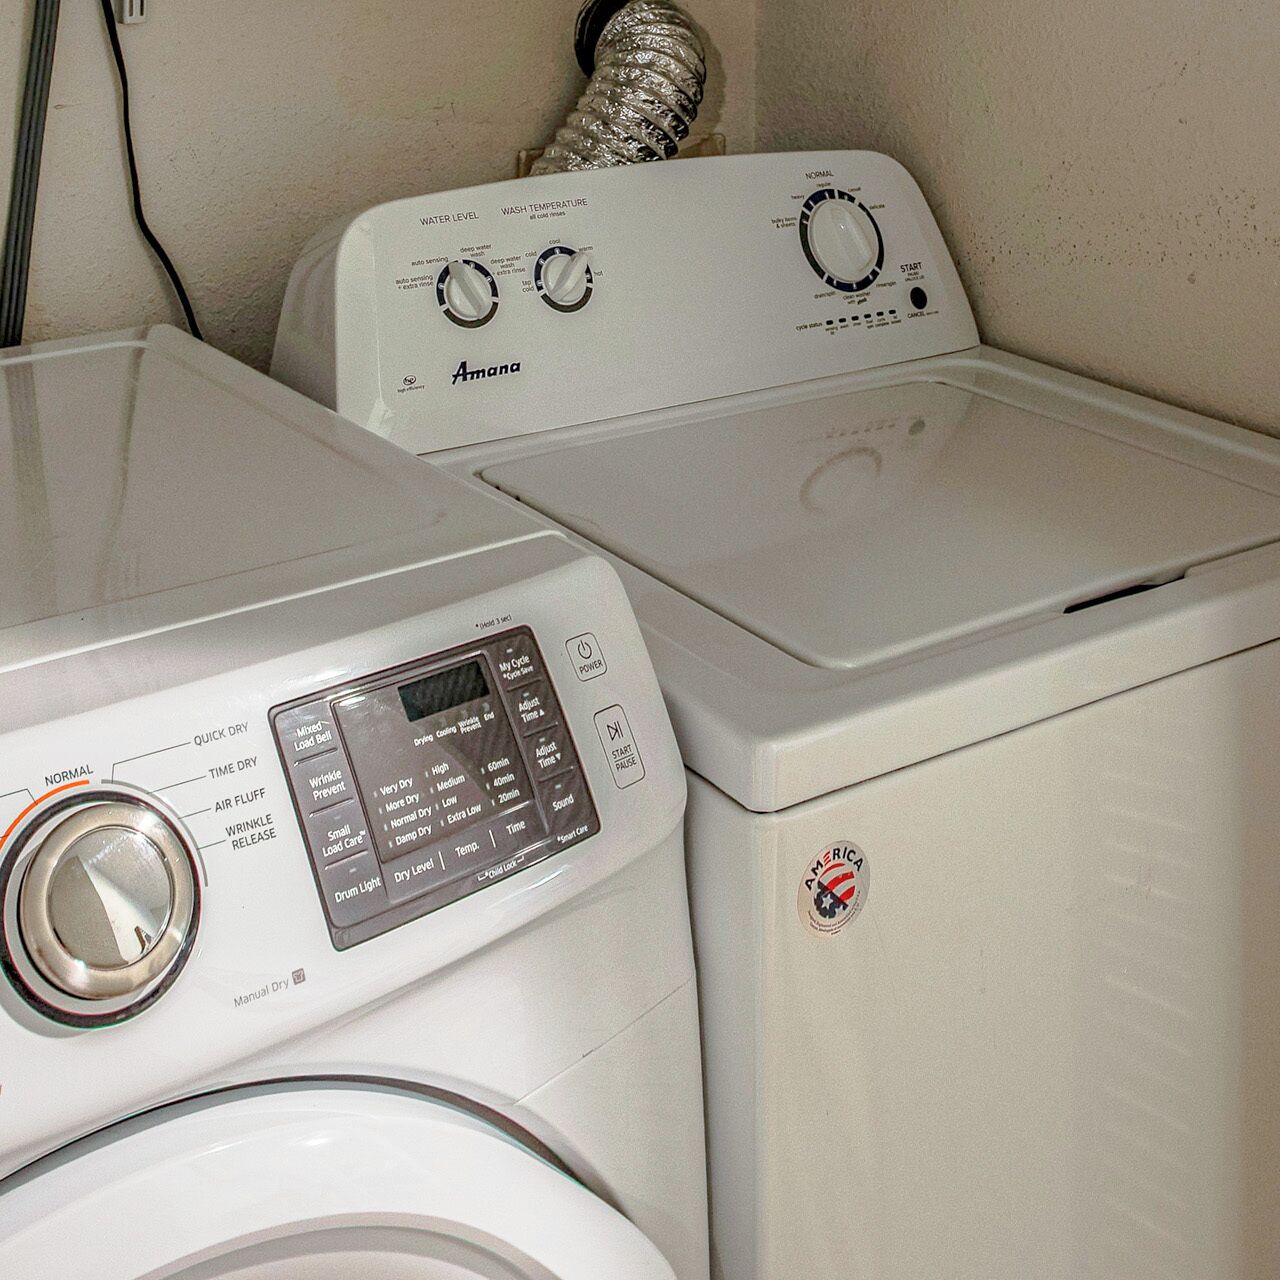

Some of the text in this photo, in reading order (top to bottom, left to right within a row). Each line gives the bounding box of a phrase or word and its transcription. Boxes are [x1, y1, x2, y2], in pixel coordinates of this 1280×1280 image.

[805, 170, 834, 179] NORMAL
[501, 198, 588, 215] WASH TEMPERATURE
[419, 211, 479, 225] WATER LEVEL
[425, 256, 449, 265] sensing
[900, 262, 923, 273] START
[410, 274, 434, 284] sensing
[452, 361, 520, 385] Amana
[499, 655, 530, 672] My Cycle
[520, 665, 533, 675] Save
[579, 659, 604, 675] POWER
[519, 697, 540, 712] Adjust
[458, 716, 480, 729] Wrinkle
[483, 711, 495, 721] End
[521, 709, 541, 723] Time
[194, 722, 250, 747] QUICK DRY
[296, 721, 323, 737] Mixed
[436, 724, 457, 738] Cooling
[460, 722, 482, 734] Prevent
[294, 730, 332, 751] Load Bell
[414, 734, 434, 746] Drying
[536, 742, 557, 758] Adjust
[611, 744, 633, 759] START
[208, 756, 258, 779] TIME DRY
[431, 762, 449, 775] High
[487, 758, 510, 772] 60min
[538, 754, 556, 769] Time
[616, 755, 637, 772] PAUSE
[45, 764, 94, 786] NORMAL
[309, 769, 342, 789] Wrinkle
[494, 773, 515, 786] 40min
[313, 781, 346, 801] Prevent
[380, 777, 413, 796] Very Dry
[436, 775, 465, 792] Medium
[215, 787, 265, 813] AIR FLUFF
[385, 793, 419, 812] More Dry
[442, 795, 457, 808] Low
[498, 789, 520, 803] 20min
[552, 793, 574, 811] Sound
[390, 806, 431, 829] Normal Dry
[447, 804, 481, 824] Extra Low
[225, 813, 273, 837] WRINKLE
[328, 824, 351, 841] Small
[506, 821, 526, 835] Time
[576, 825, 588, 836] Care
[232, 827, 276, 850] RELEASE
[395, 825, 431, 846] Damp Dry
[322, 840, 343, 857] Load
[455, 842, 479, 857] Temp.
[394, 858, 434, 883] Dry Level
[504, 859, 518, 872] Lock
[804, 846, 864, 891] AMERICA
[335, 876, 381, 903] Drum Light
[233, 979, 289, 1007] Manual Dry
